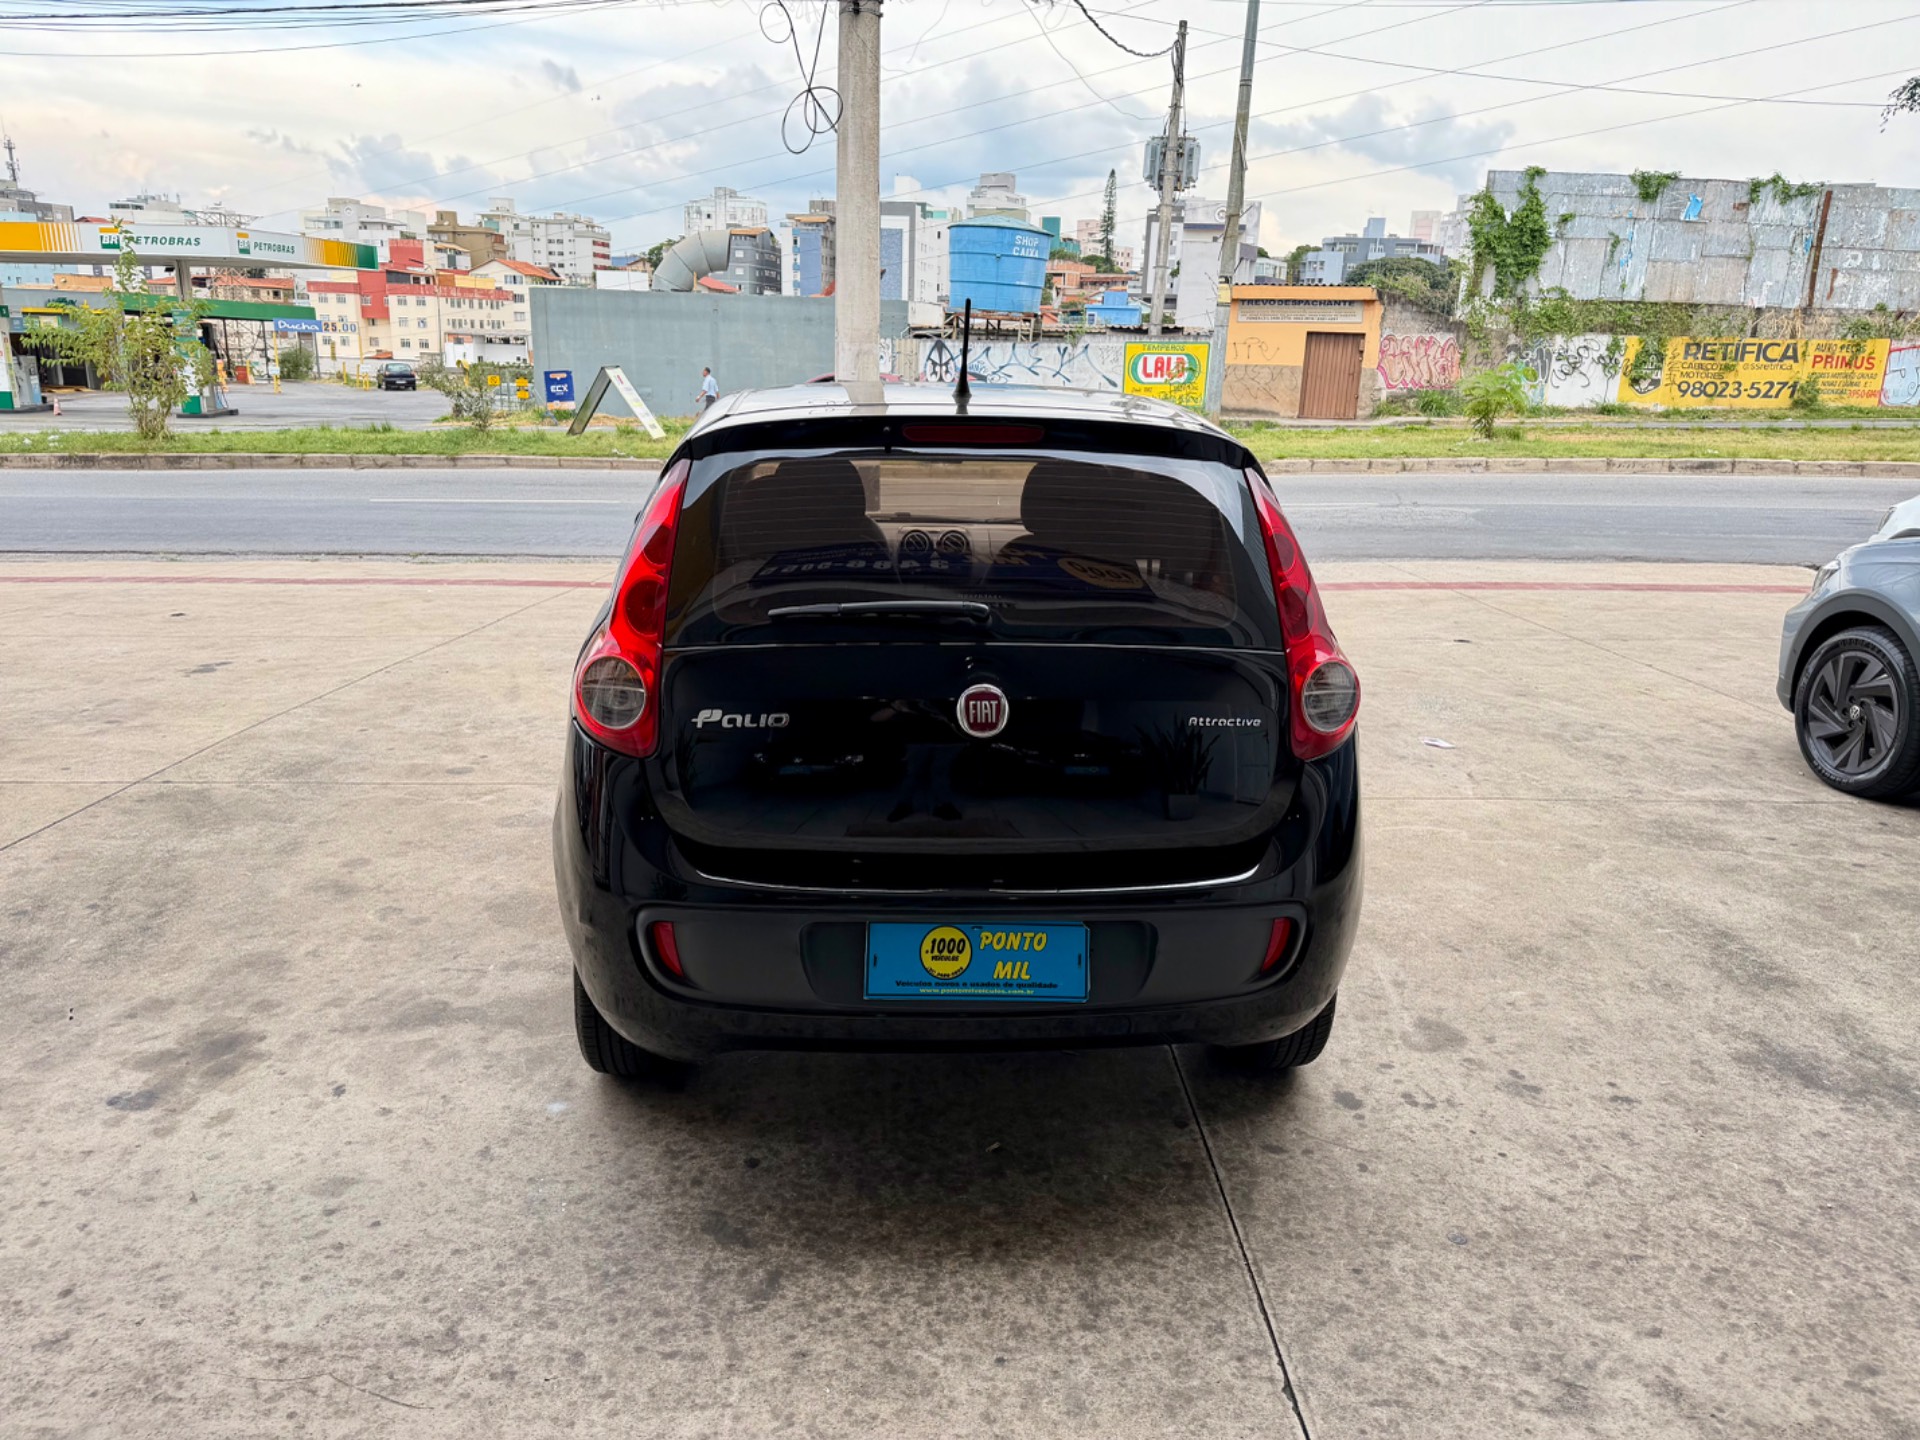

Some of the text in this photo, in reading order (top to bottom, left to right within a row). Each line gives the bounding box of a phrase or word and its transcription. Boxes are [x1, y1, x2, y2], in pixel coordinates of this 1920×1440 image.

[101, 235, 120, 244] BR
[124, 236, 200, 246] ETROBRAS
[1015, 235, 1039, 247] SHOP
[254, 241, 295, 254] PETROBRAS
[1013, 247, 1039, 258] CAIXA
[278, 320, 320, 330] Ducha
[1683, 339, 1799, 363] RETÍFICA
[1142, 356, 1187, 380] LALO
[1811, 354, 1876, 371] PRIMUS
[1680, 371, 1725, 380] MOTORES
[1677, 380, 1800, 399] 98023-5271
[969, 700, 998, 724] FIAT
[1188, 716, 1262, 727] Attractive
[980, 932, 1047, 951] PONTO
[993, 961, 1031, 980] MIL
